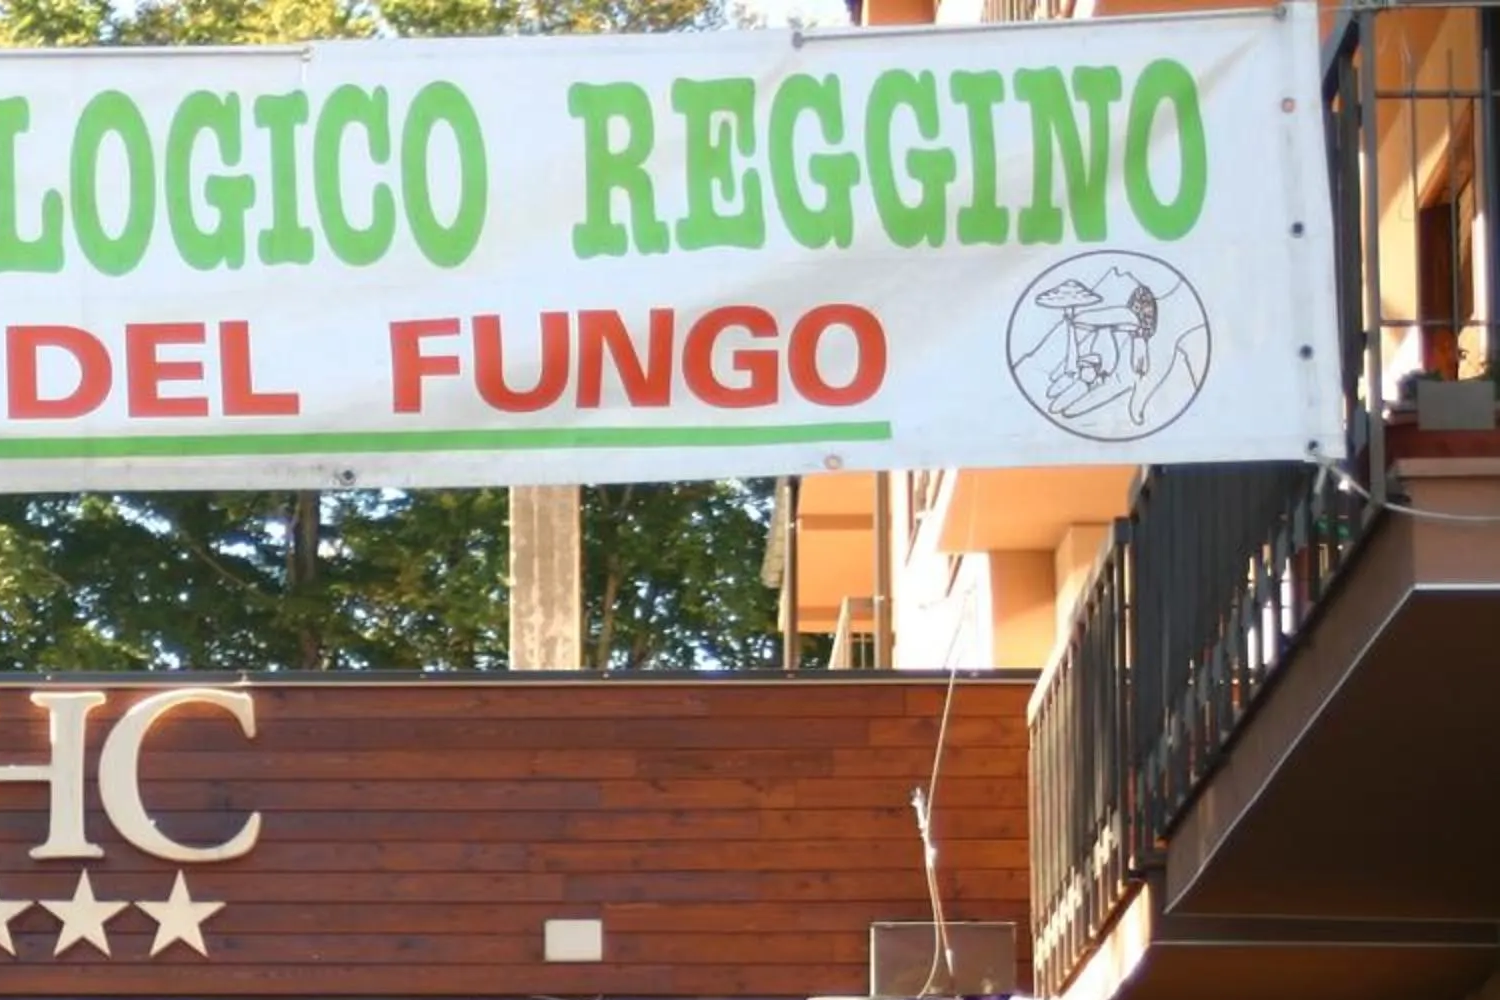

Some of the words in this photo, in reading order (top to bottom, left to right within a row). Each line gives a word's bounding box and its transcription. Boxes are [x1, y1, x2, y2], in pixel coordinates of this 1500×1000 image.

[570, 59, 1208, 258] REGGINO
[8, 321, 300, 418] DEL
[391, 304, 887, 413] FUNGO
